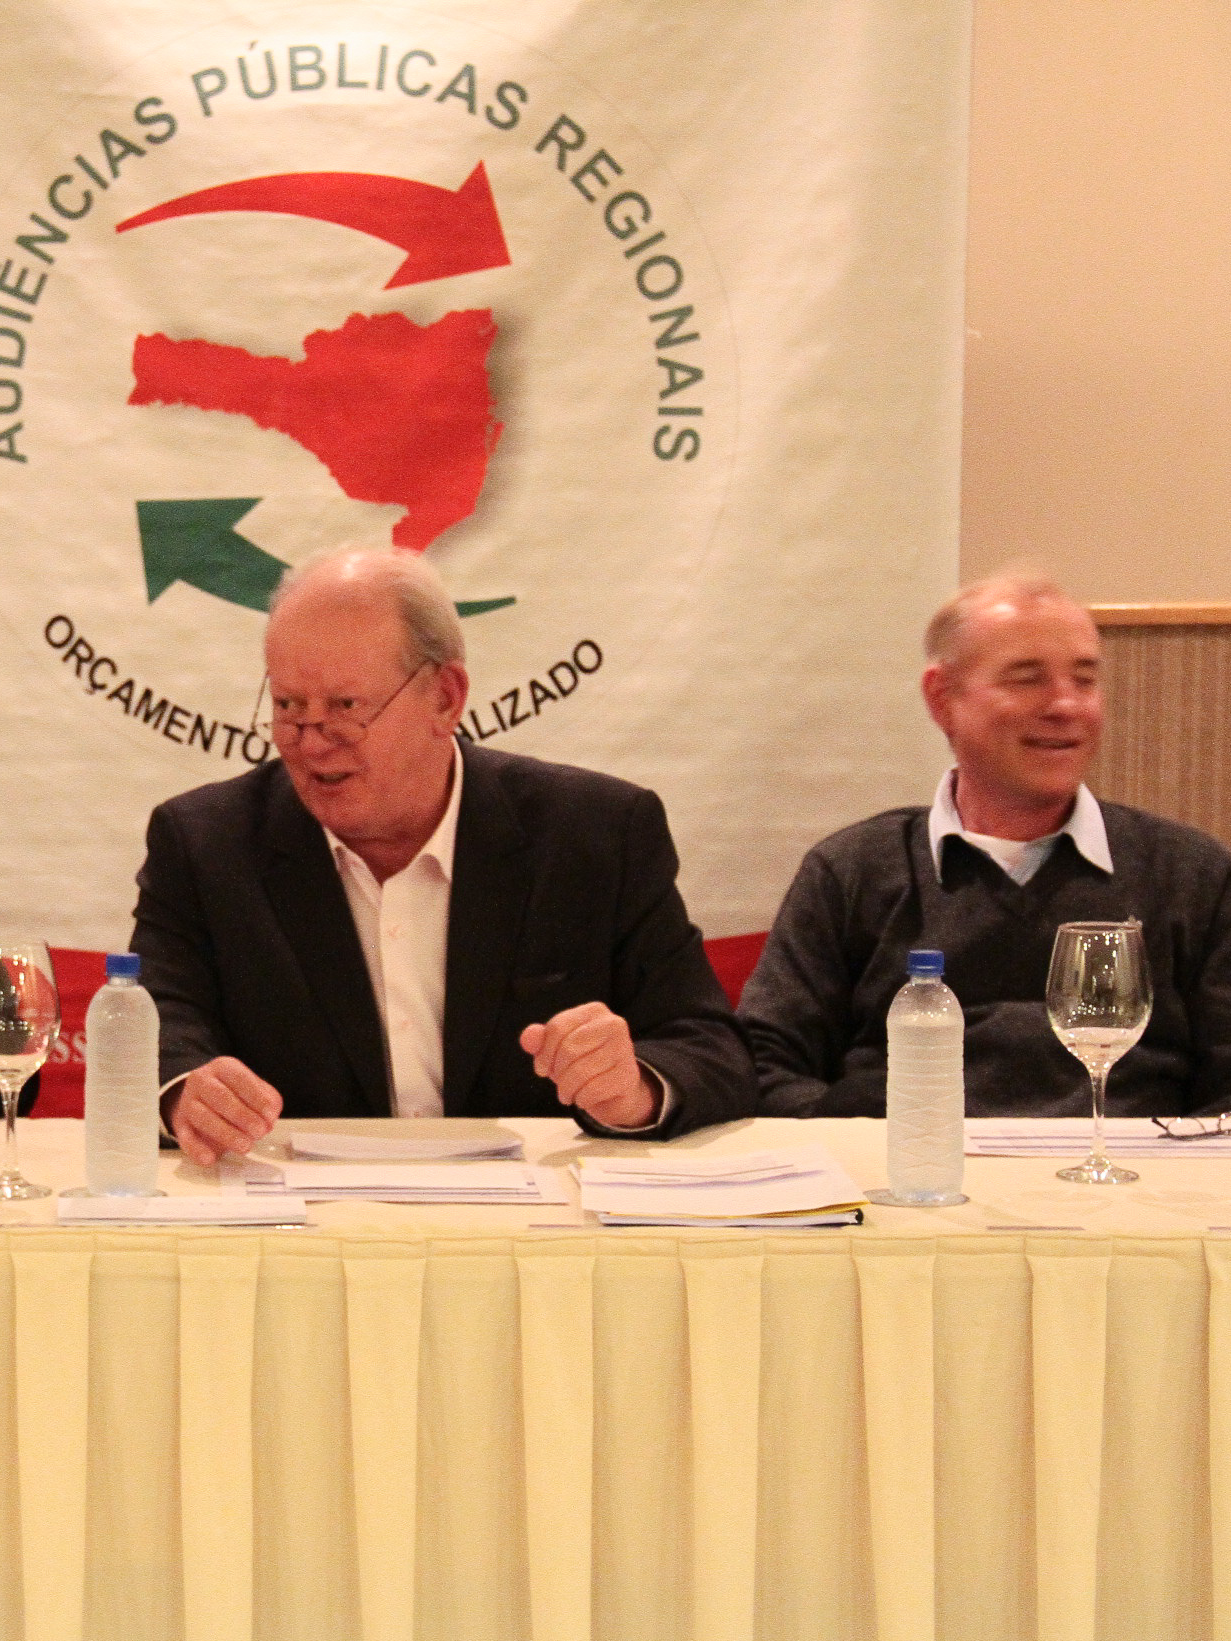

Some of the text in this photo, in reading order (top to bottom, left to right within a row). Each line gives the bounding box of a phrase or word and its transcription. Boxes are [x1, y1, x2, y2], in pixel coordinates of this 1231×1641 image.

[191, 41, 529, 132] PÚBLICAS
[535, 113, 706, 463] REGIONAIS
[44, 614, 271, 764] ORÇAMENTO
